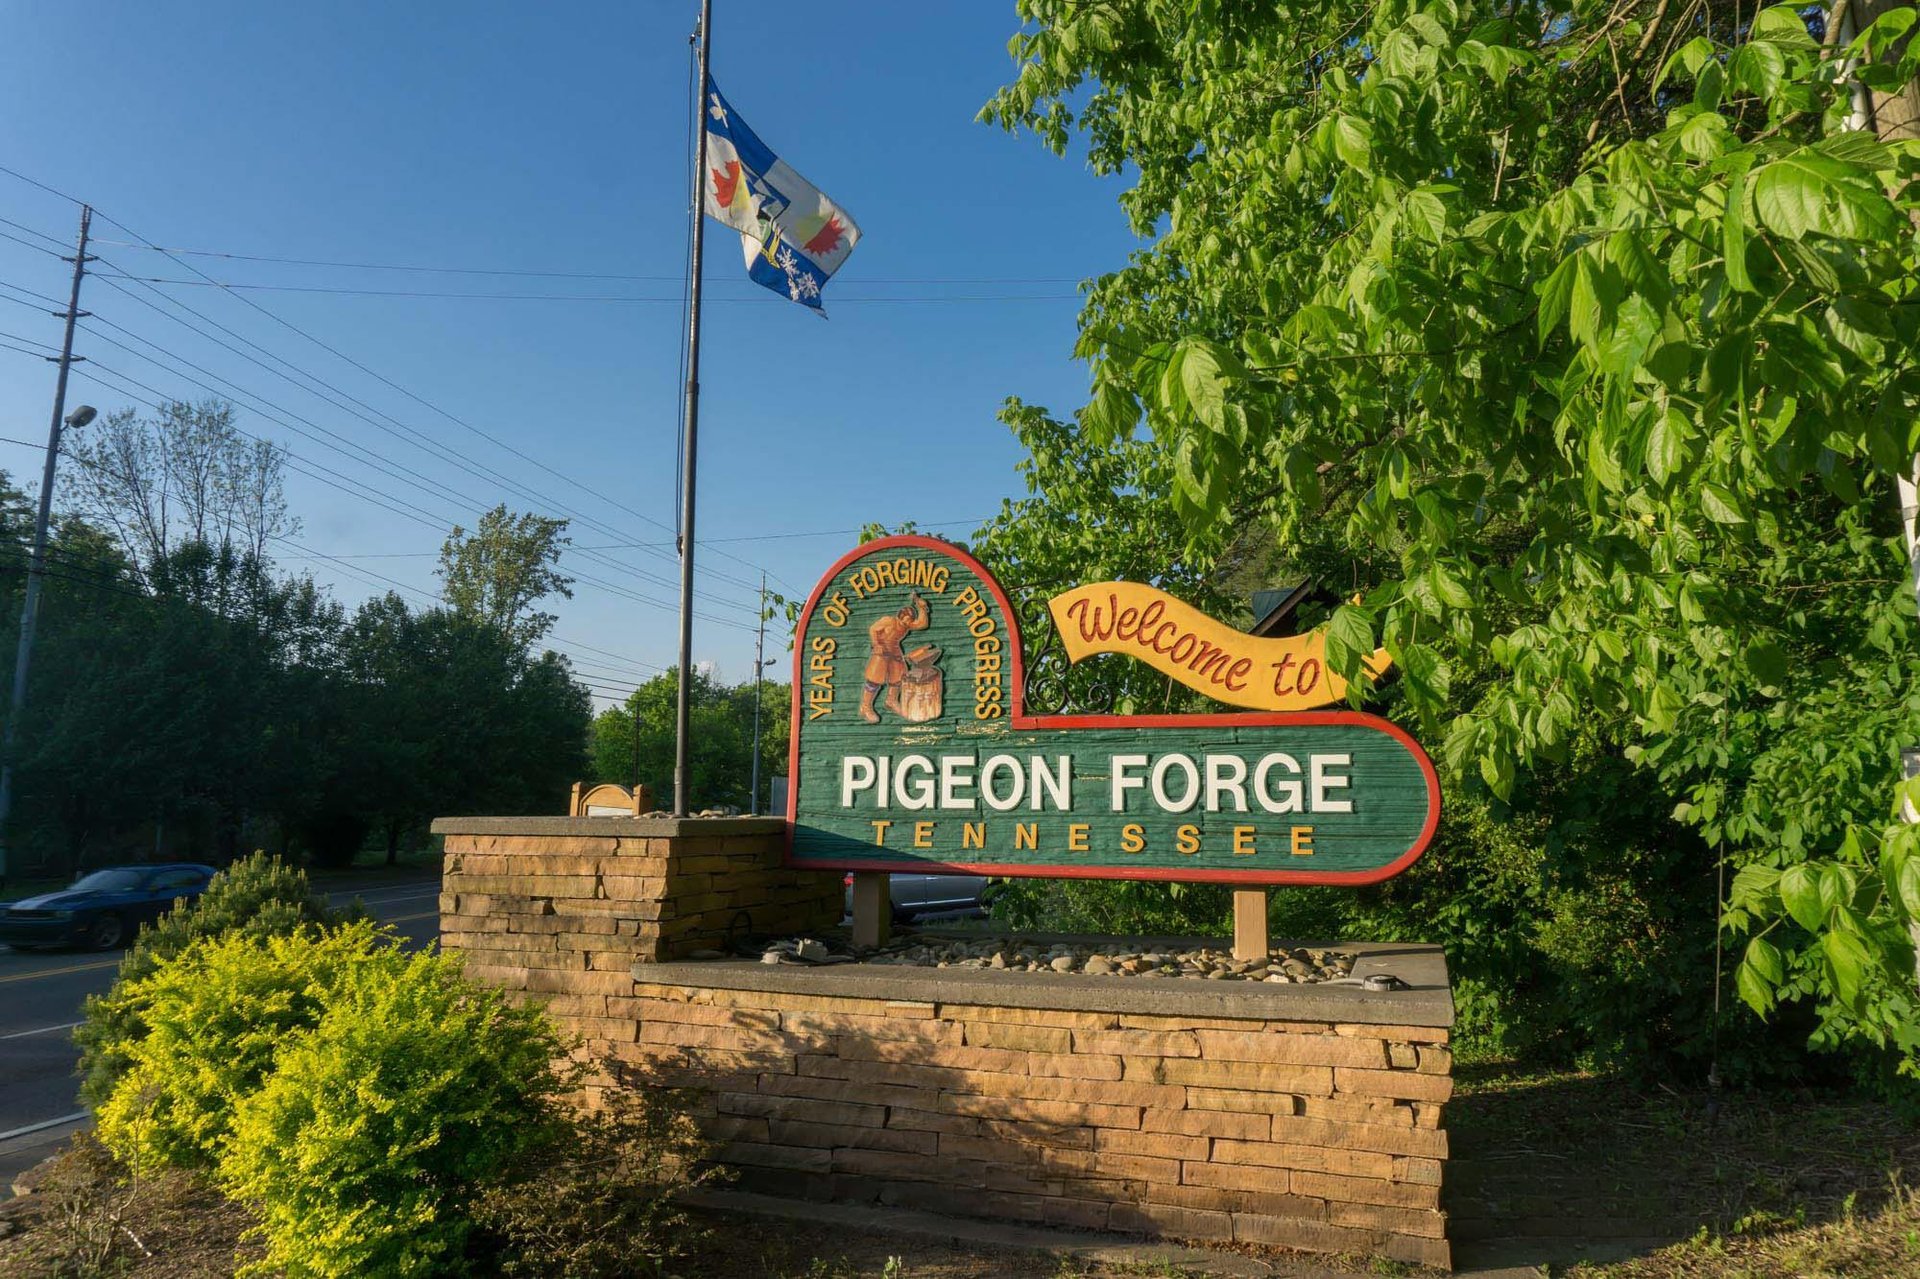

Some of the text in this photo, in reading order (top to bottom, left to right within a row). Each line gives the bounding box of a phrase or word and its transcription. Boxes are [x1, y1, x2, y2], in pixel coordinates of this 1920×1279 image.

[810, 558, 1002, 720] YEARS OF FORGING PROGRESS
[1067, 593, 1321, 696] Welcome to
[842, 752, 1354, 814] PIGEON FORGE
[871, 820, 1315, 856] TENNESSEE
